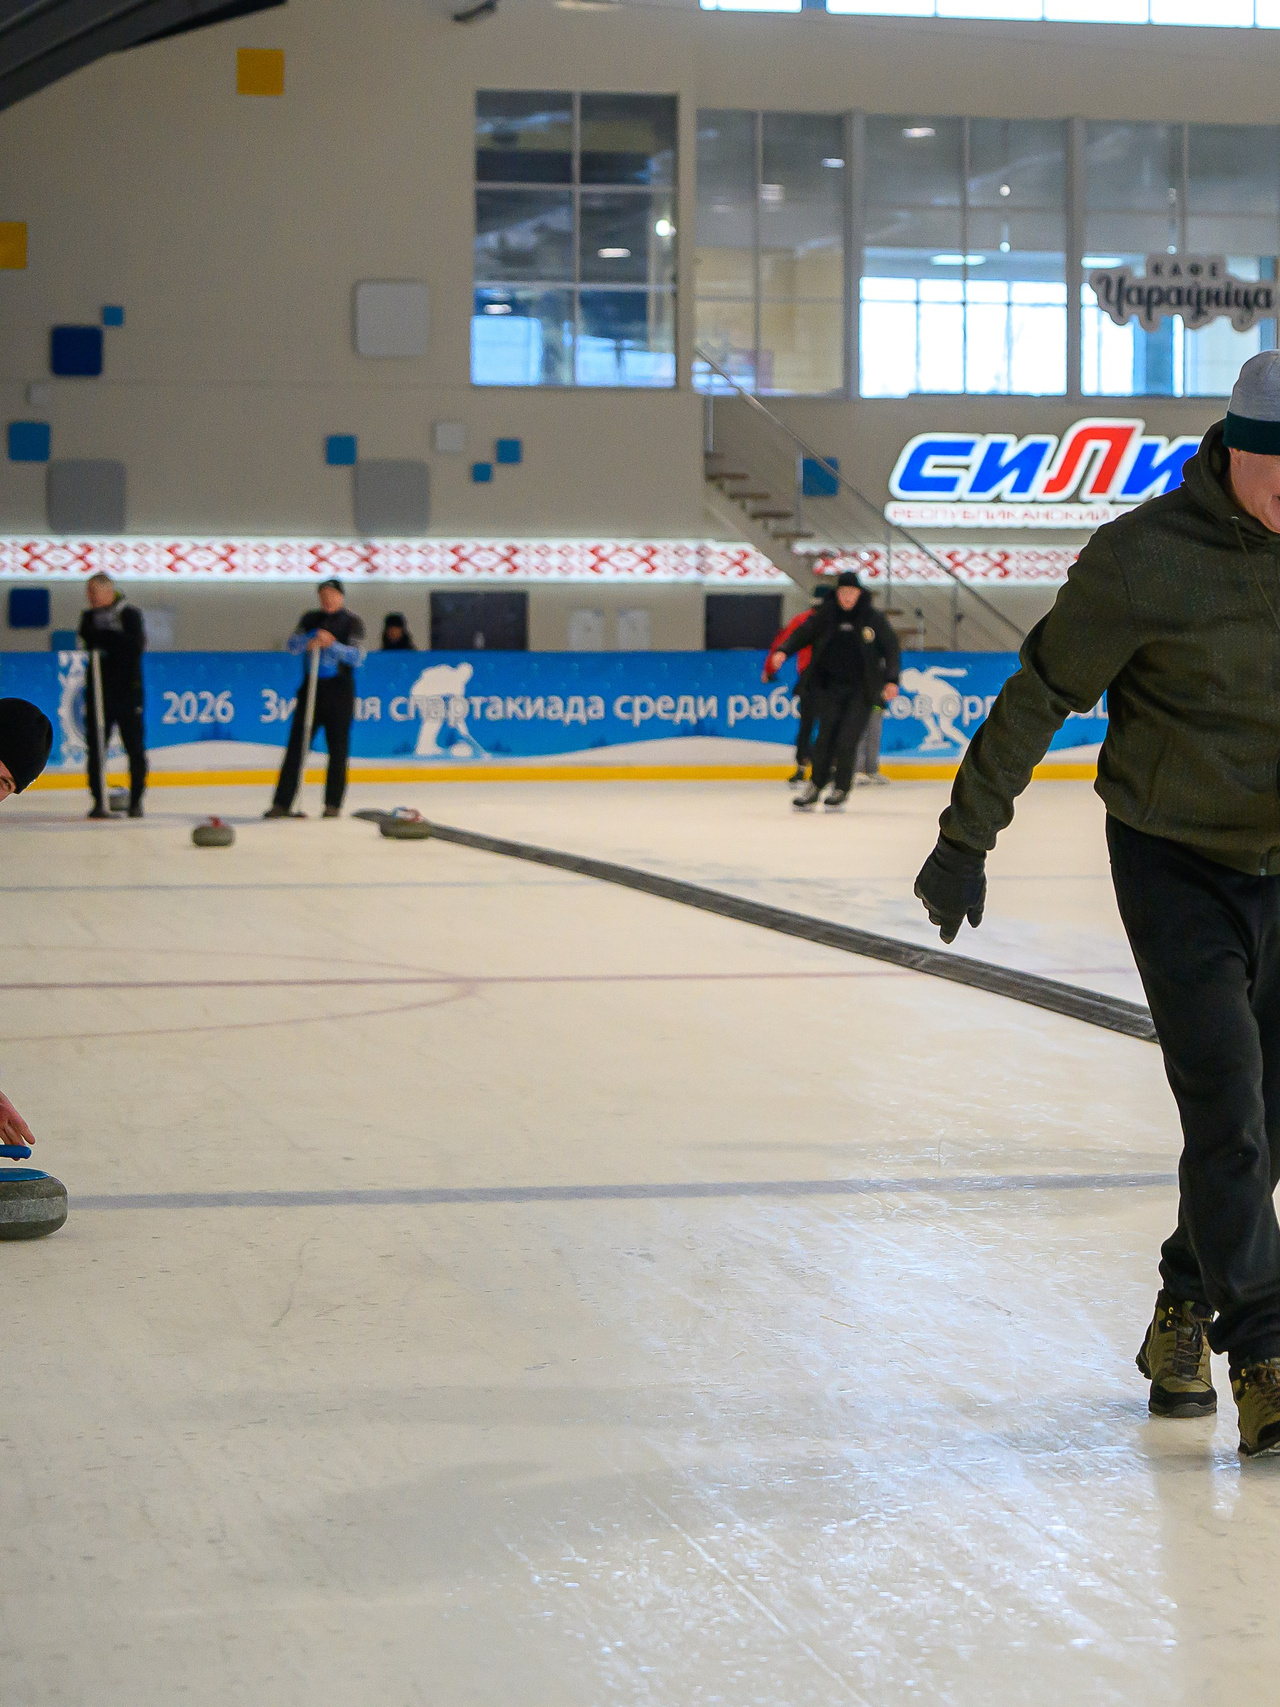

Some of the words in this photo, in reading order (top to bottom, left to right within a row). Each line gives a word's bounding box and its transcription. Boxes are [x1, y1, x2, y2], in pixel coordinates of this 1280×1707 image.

[895, 425, 1201, 498] СИЛИ
[161, 690, 235, 725] 2026
[388, 694, 606, 729] спартакиада
[613, 693, 719, 729] среди
